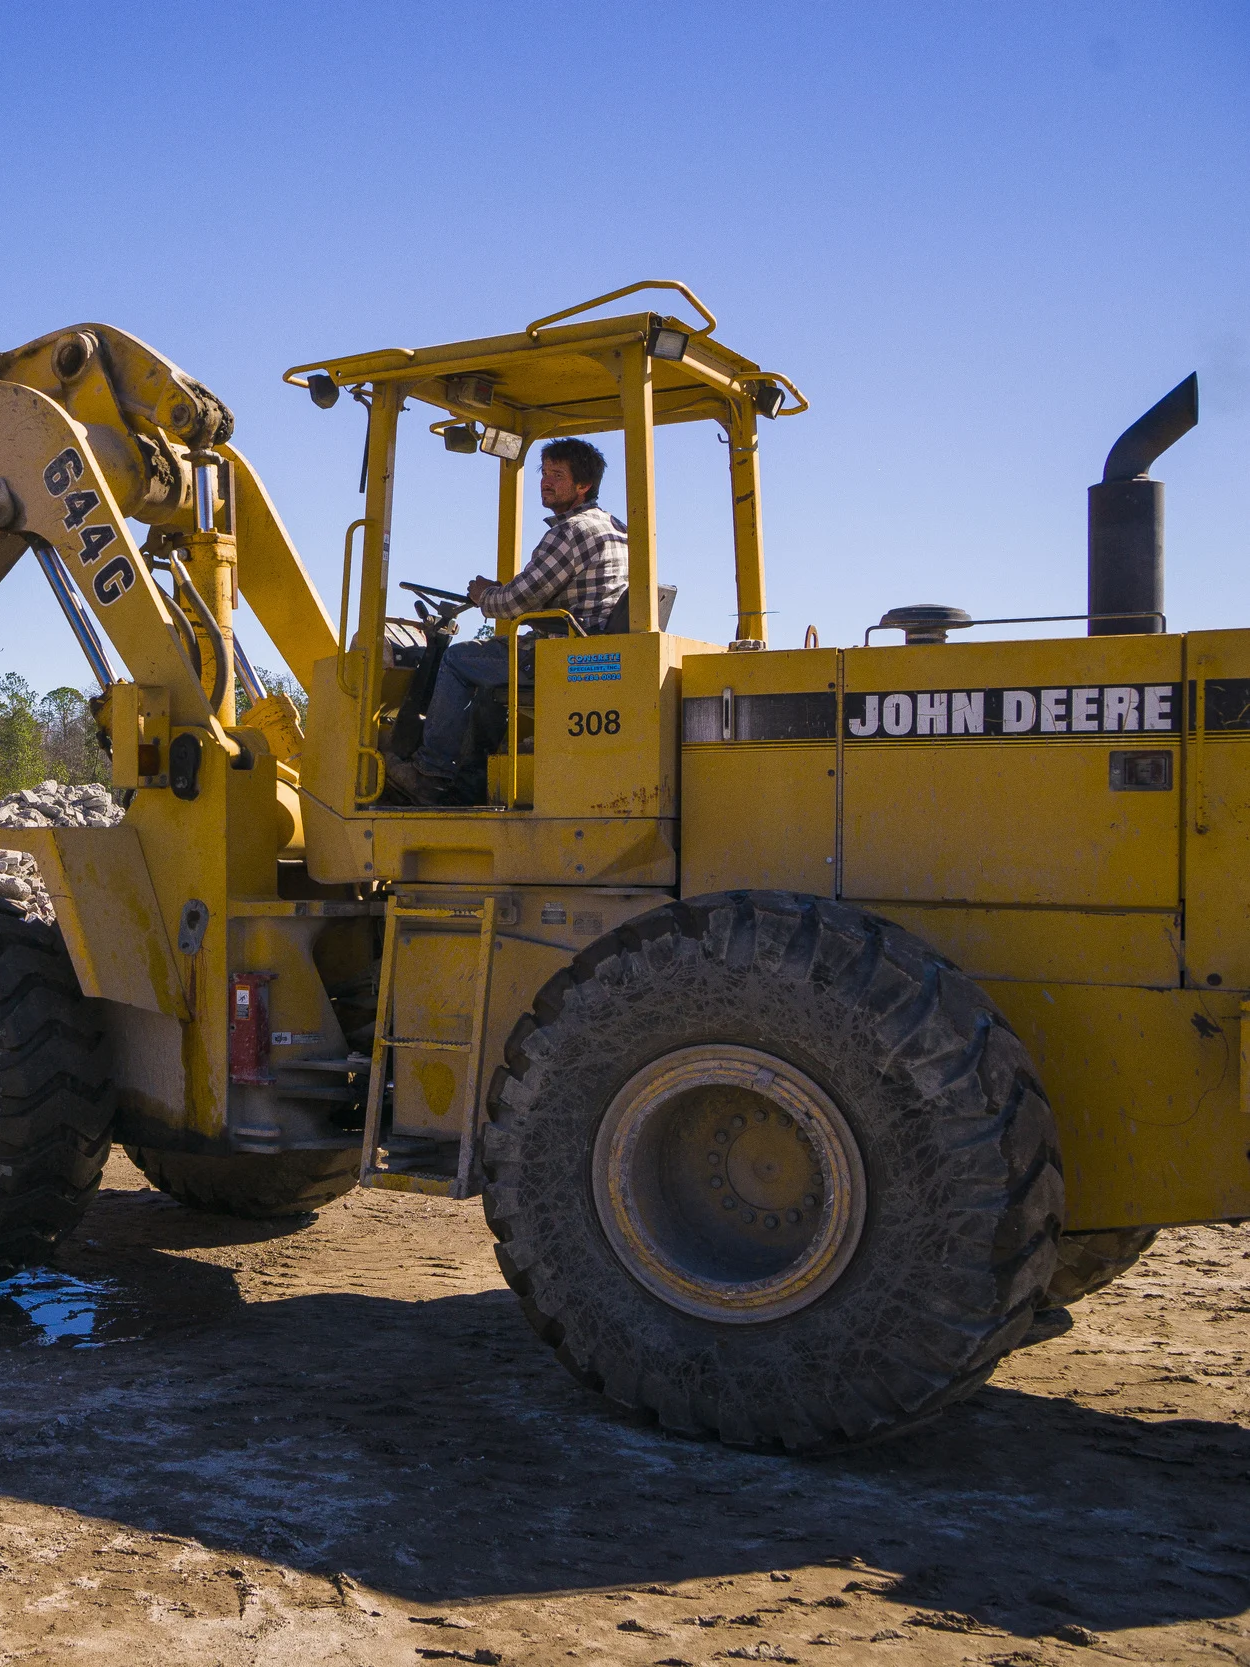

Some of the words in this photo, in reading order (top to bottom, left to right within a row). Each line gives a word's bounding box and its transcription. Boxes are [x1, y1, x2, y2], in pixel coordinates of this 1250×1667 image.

[43, 447, 136, 606] 644G
[567, 652, 621, 664] CONCRETE
[568, 710, 621, 737] 308
[848, 691, 985, 737] JOHN
[1002, 685, 1173, 734] DEERE
